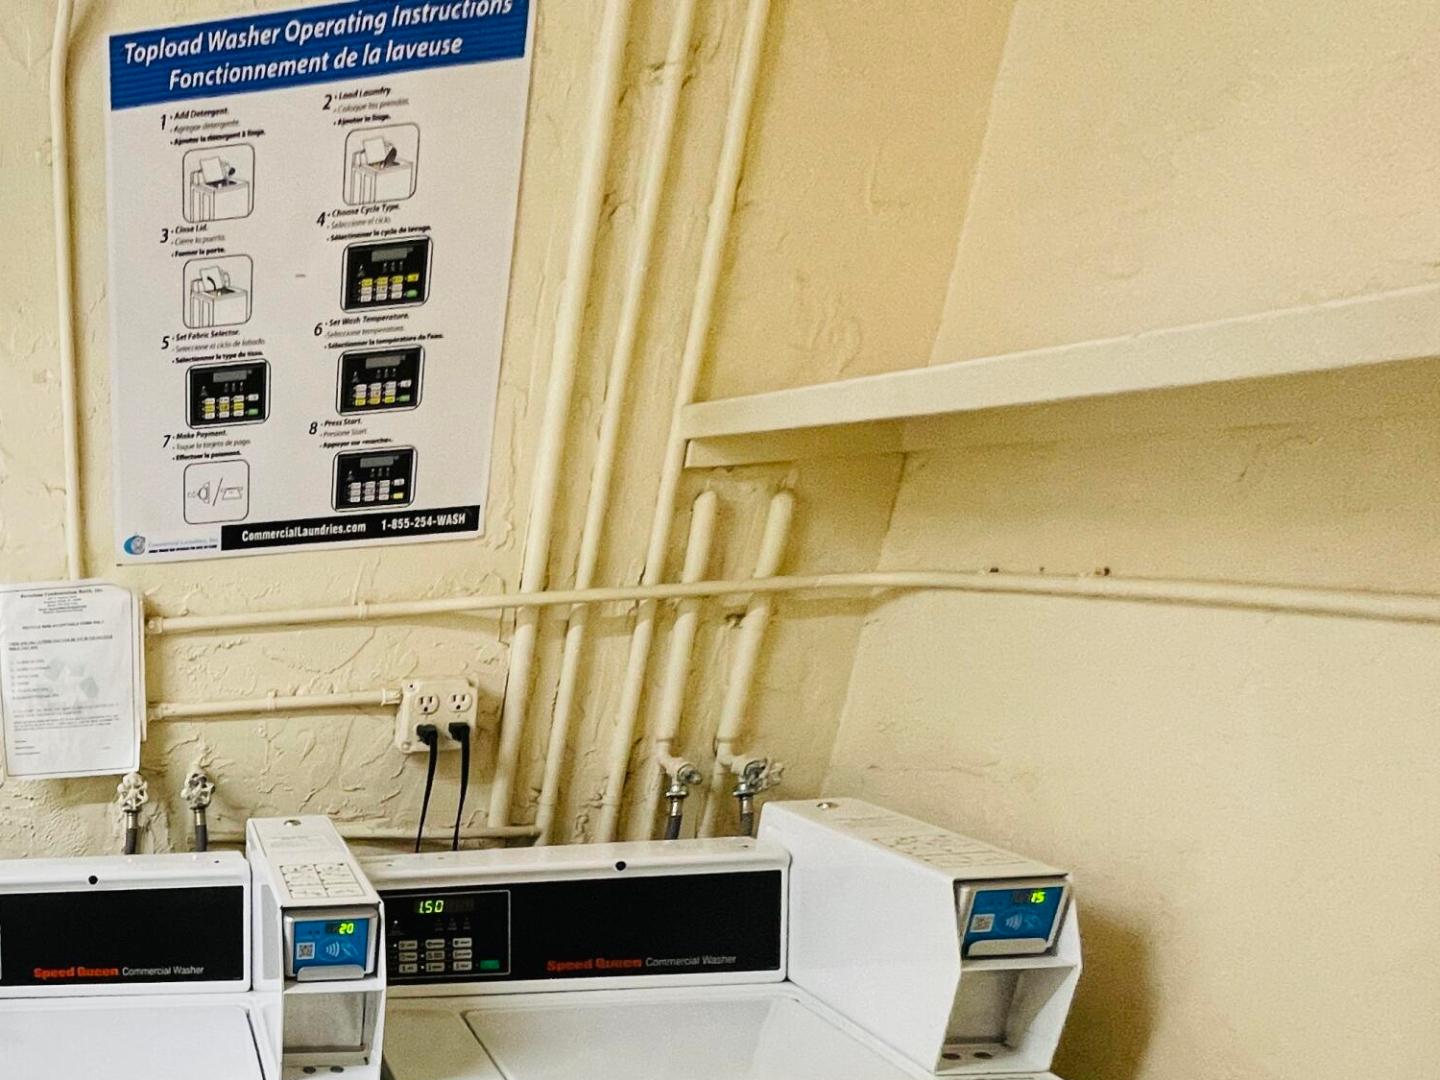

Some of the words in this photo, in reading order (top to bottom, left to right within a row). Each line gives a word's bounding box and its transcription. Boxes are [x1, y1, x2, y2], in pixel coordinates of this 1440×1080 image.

[125, 32, 202, 67] Topload
[207, 24, 278, 53] Washer
[285, 9, 386, 46] Operating
[391, 0, 512, 28] Instructions
[169, 51, 328, 90] Fonctionnement
[334, 49, 356, 70] de
[362, 44, 380, 65] la
[386, 35, 463, 61] laveuse
[322, 93, 332, 110] 2
[161, 114, 166, 130] 1
[174, 110, 189, 120] Add
[316, 211, 326, 227] 4
[331, 208, 359, 217] Choose
[360, 205, 379, 215] Cycle
[160, 228, 169, 243] 3
[314, 322, 323, 336] 6
[329, 319, 341, 327] Set
[161, 335, 170, 350] 5
[176, 333, 187, 341] Set
[188, 332, 209, 341] Fabric
[309, 422, 318, 435] 8
[163, 434, 171, 449] 7
[176, 432, 195, 440] Make
[241, 521, 367, 544] CommercialLaundries.com
[381, 513, 466, 532] 1-855-254-WASH
[1031, 891, 1047, 904] 15
[339, 922, 354, 935] 20
[546, 958, 593, 972] Speed
[595, 957, 642, 969] Queen
[645, 956, 700, 968] Commercial
[702, 955, 737, 965] Washer
[33, 966, 75, 980] Speed
[77, 966, 119, 977] Queen
[122, 966, 172, 977] Commercial
[173, 965, 205, 975] Washer
